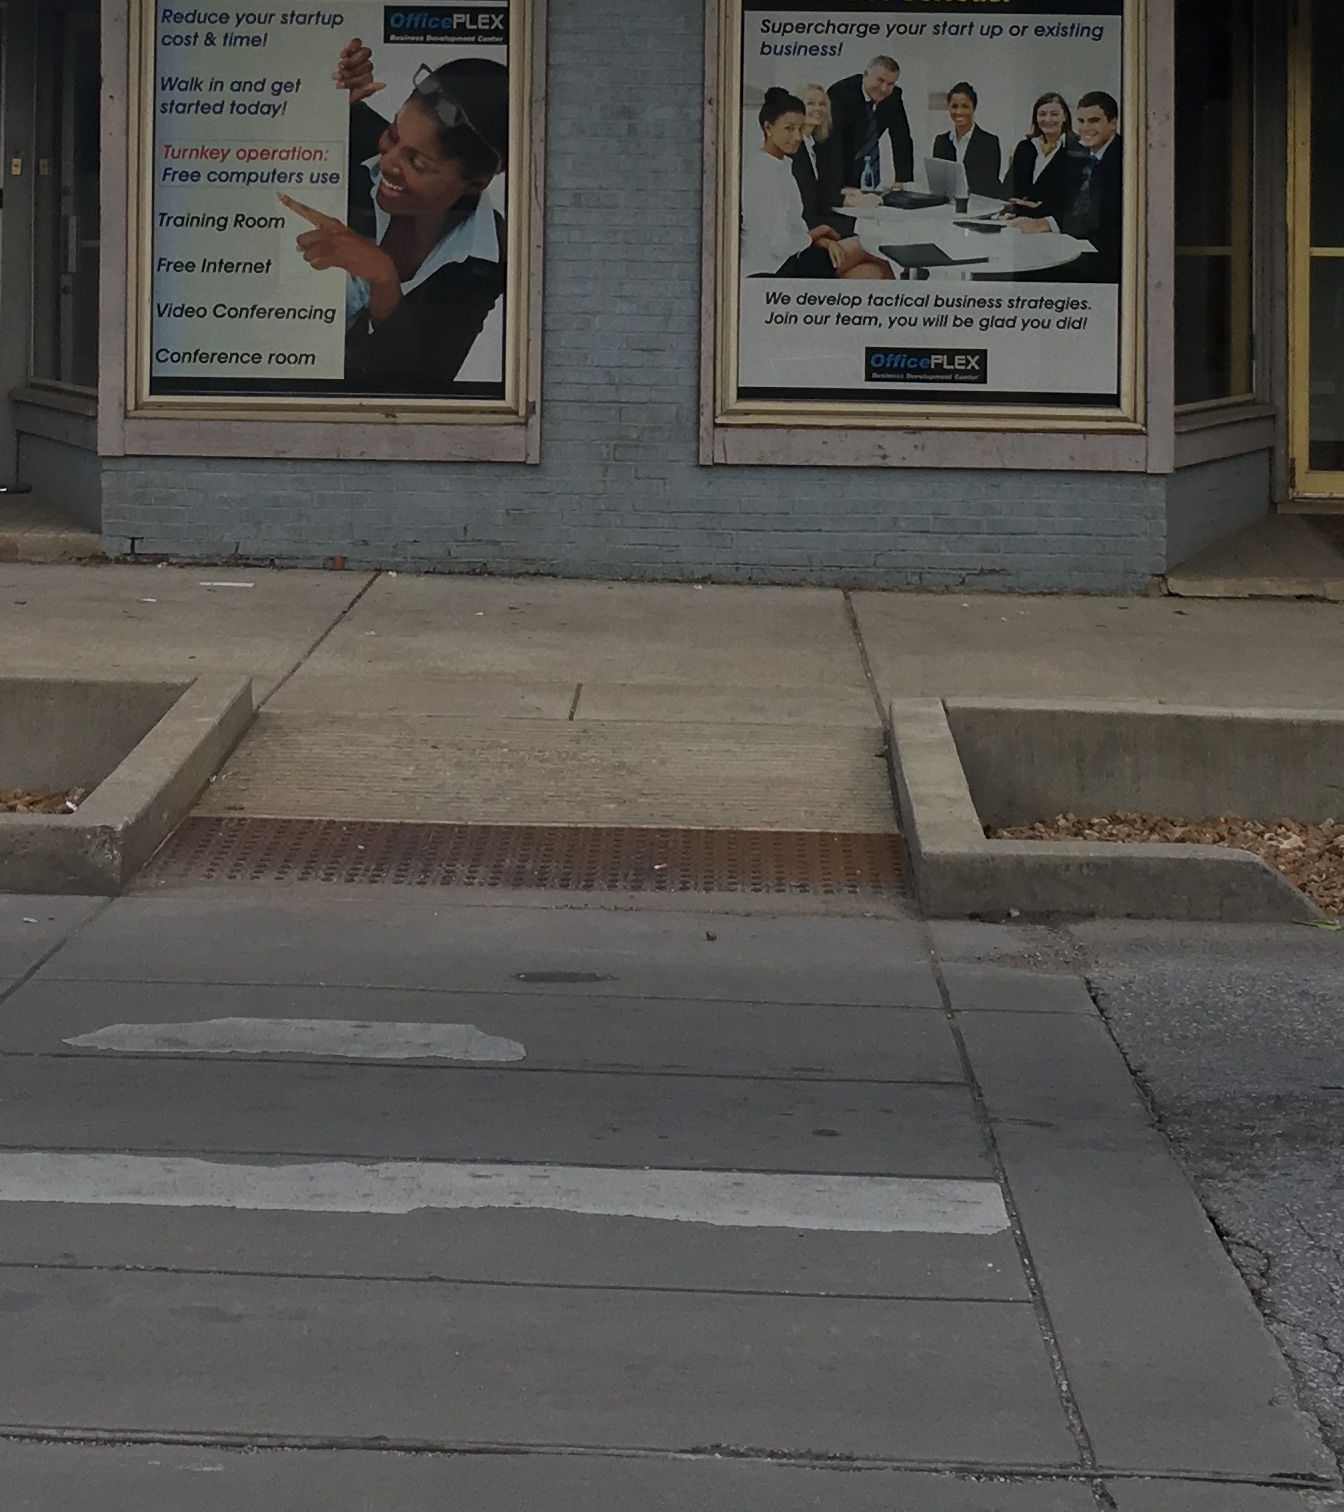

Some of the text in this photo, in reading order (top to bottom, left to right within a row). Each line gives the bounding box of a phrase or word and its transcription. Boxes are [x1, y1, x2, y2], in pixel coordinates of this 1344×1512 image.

[161, 9, 344, 28] Reduce your startup
[390, 12, 504, 30] OfficePLEX
[760, 19, 1104, 41] Supercharge your start up or existing
[161, 32, 268, 47] cost & time!
[760, 41, 844, 56] business!
[160, 77, 302, 96] Walk in and get
[159, 100, 287, 118] started today!
[163, 145, 329, 163] Turnkey operation:
[161, 167, 340, 185] Free computers use
[158, 213, 286, 231] Training Room
[156, 258, 272, 274] Free Internet
[765, 291, 1092, 313] We develop tactical business strategies.
[156, 303, 336, 323] Video Conferencing
[764, 311, 1088, 331] Join our team, you will be glad you did!
[155, 348, 316, 365] Conference room
[870, 353, 980, 369] OfficePLEX
